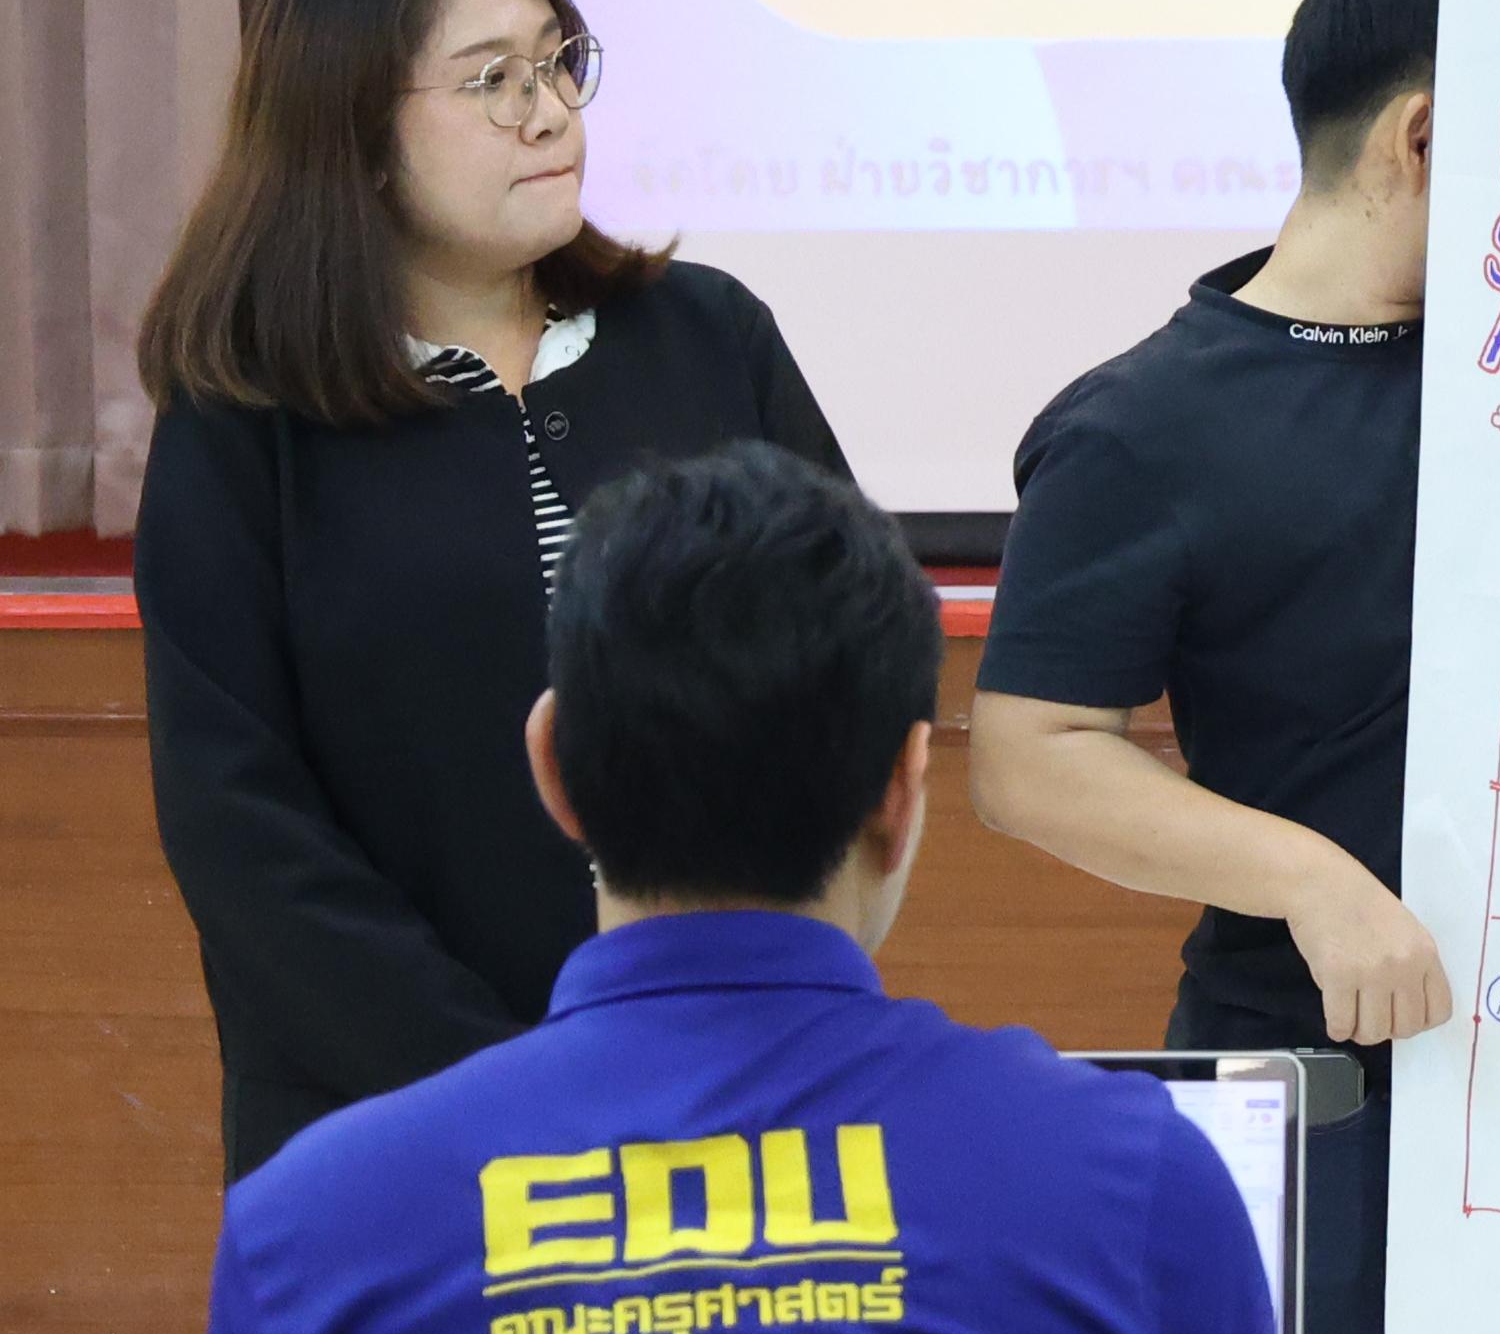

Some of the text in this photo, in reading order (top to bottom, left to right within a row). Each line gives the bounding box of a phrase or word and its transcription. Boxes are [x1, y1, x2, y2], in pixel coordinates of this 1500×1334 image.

[1289, 323, 1344, 344] Calvin
[1349, 328, 1389, 344] Klein
[478, 1124, 899, 1276] EDU
